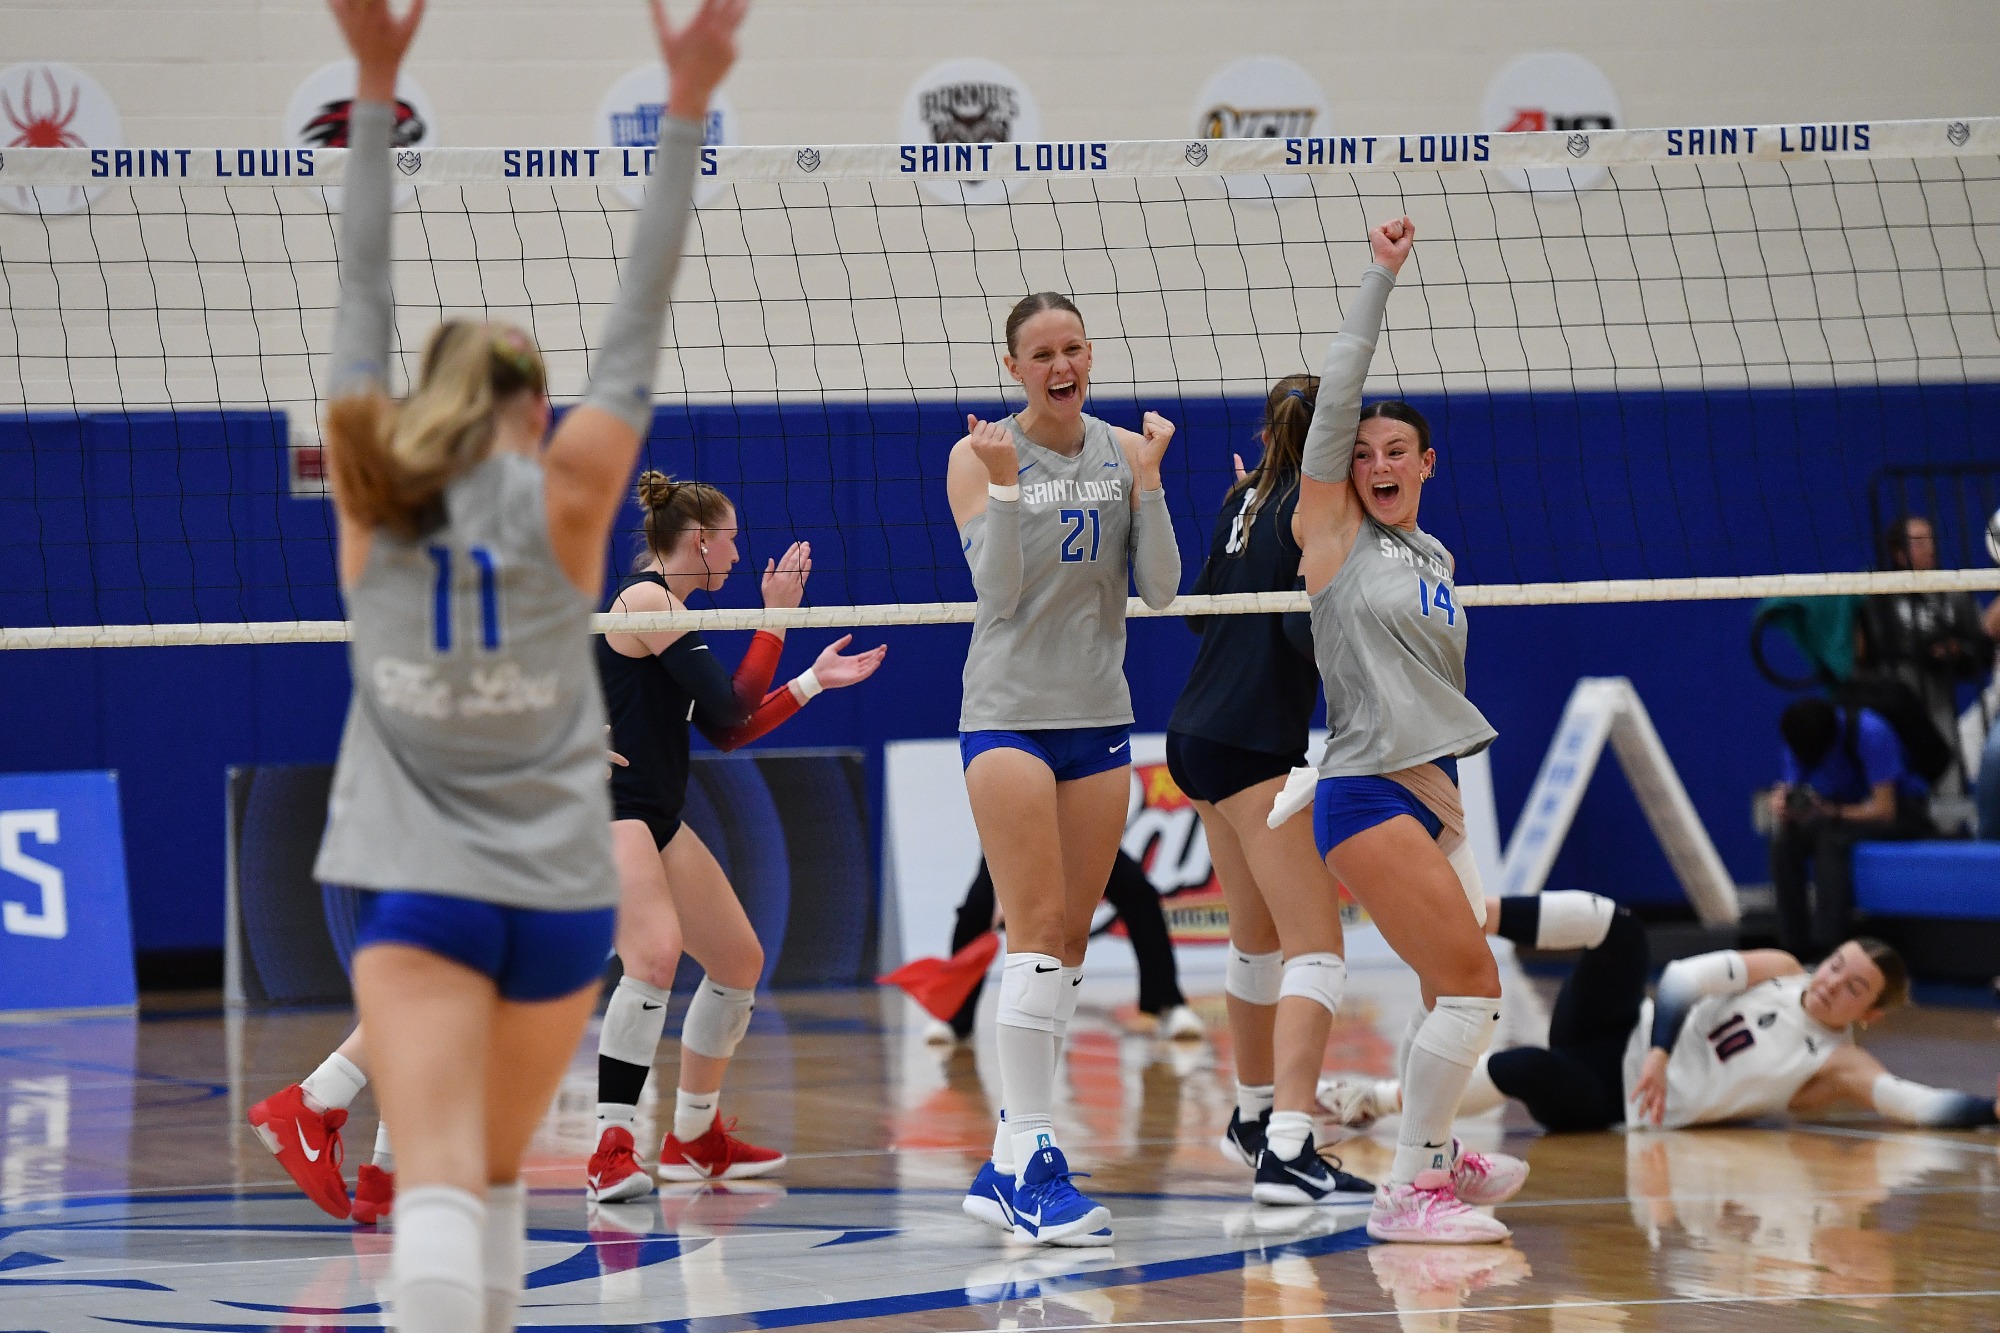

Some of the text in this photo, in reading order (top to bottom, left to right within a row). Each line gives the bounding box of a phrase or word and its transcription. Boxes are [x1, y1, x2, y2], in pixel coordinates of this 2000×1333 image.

[1285, 134, 1490, 165] SAINT LOUIS
[1666, 124, 1871, 156] SAINT LOUIS
[91, 149, 315, 177] SAINT LOUIS
[503, 149, 718, 177] SAINT LOS
[899, 143, 1108, 173] SAINT LOUIS
[1022, 479, 1123, 505] SAINT LOUIS
[1058, 509, 1101, 563] 21
[423, 543, 503, 655] 11
[1414, 572, 1455, 627] 14
[1707, 1013, 1756, 1062] 10
